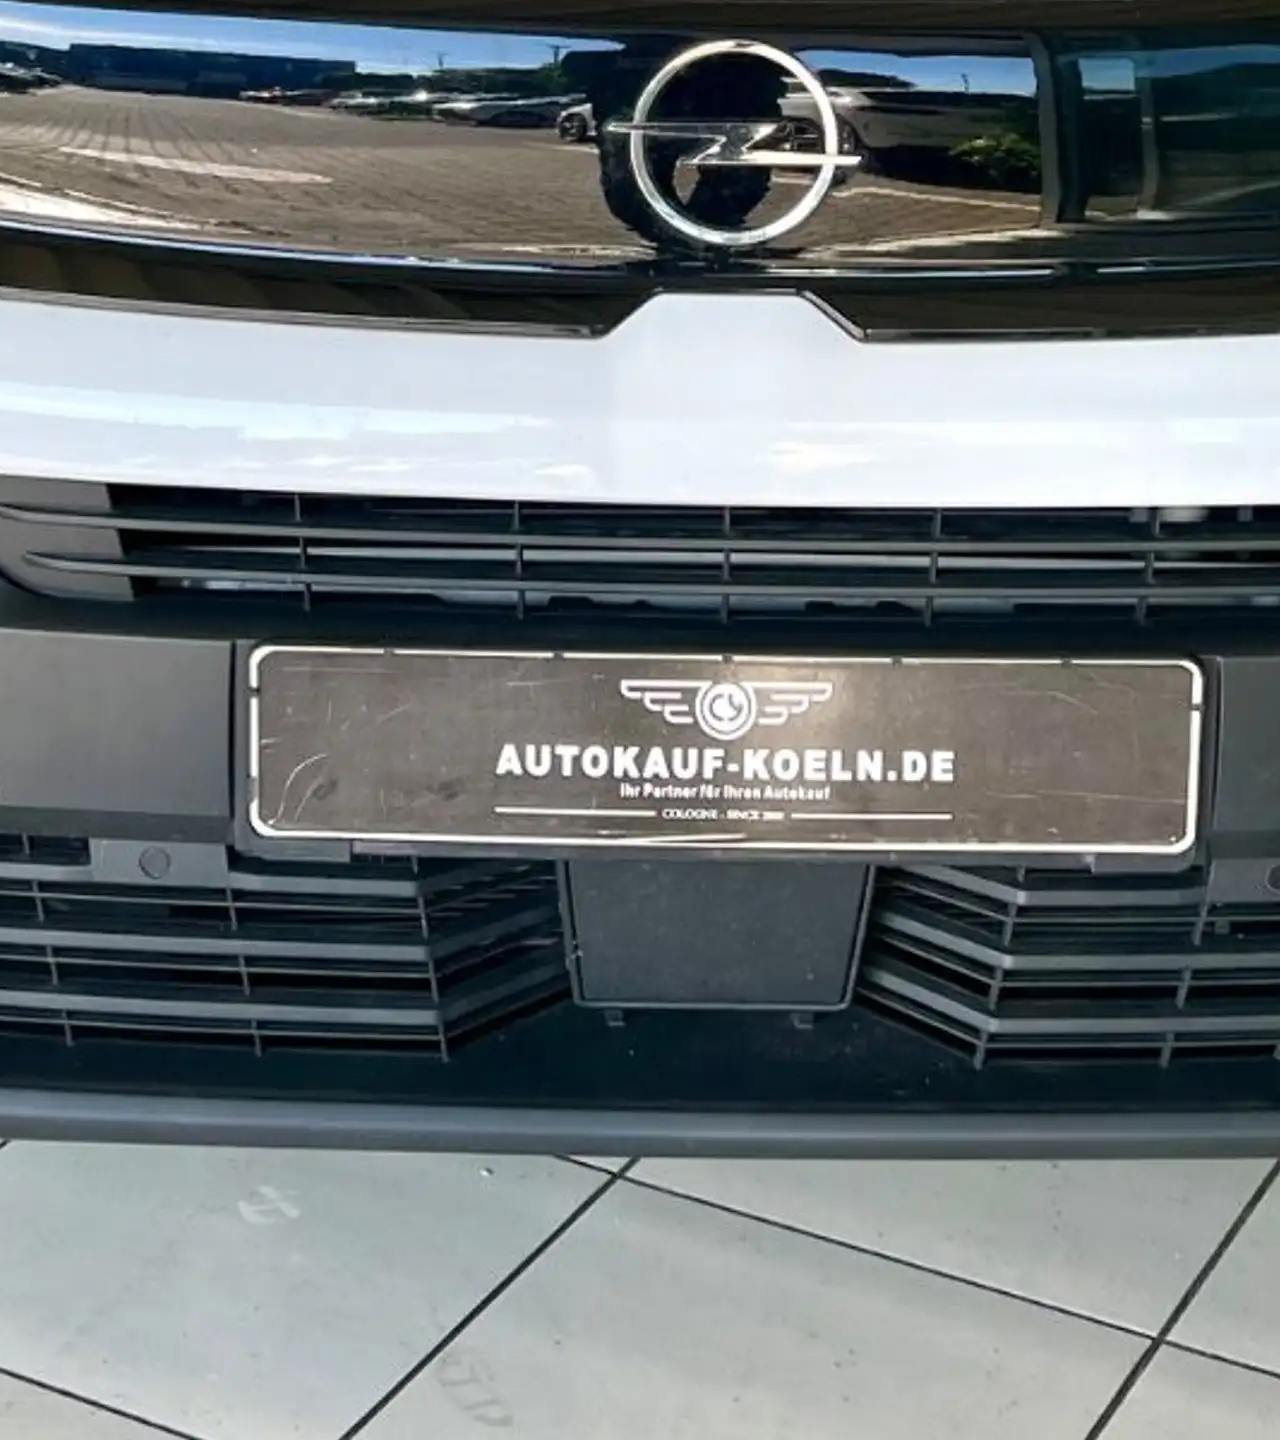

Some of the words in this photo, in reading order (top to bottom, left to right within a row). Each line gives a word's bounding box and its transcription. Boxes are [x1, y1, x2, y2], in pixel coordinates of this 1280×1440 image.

[495, 743, 955, 782] AUTOKAUF-KOELN.DE
[620, 783, 641, 799] Ihr
[642, 783, 697, 799] Partner
[723, 785, 761, 800] Ihren
[762, 785, 831, 801] Autokauf
